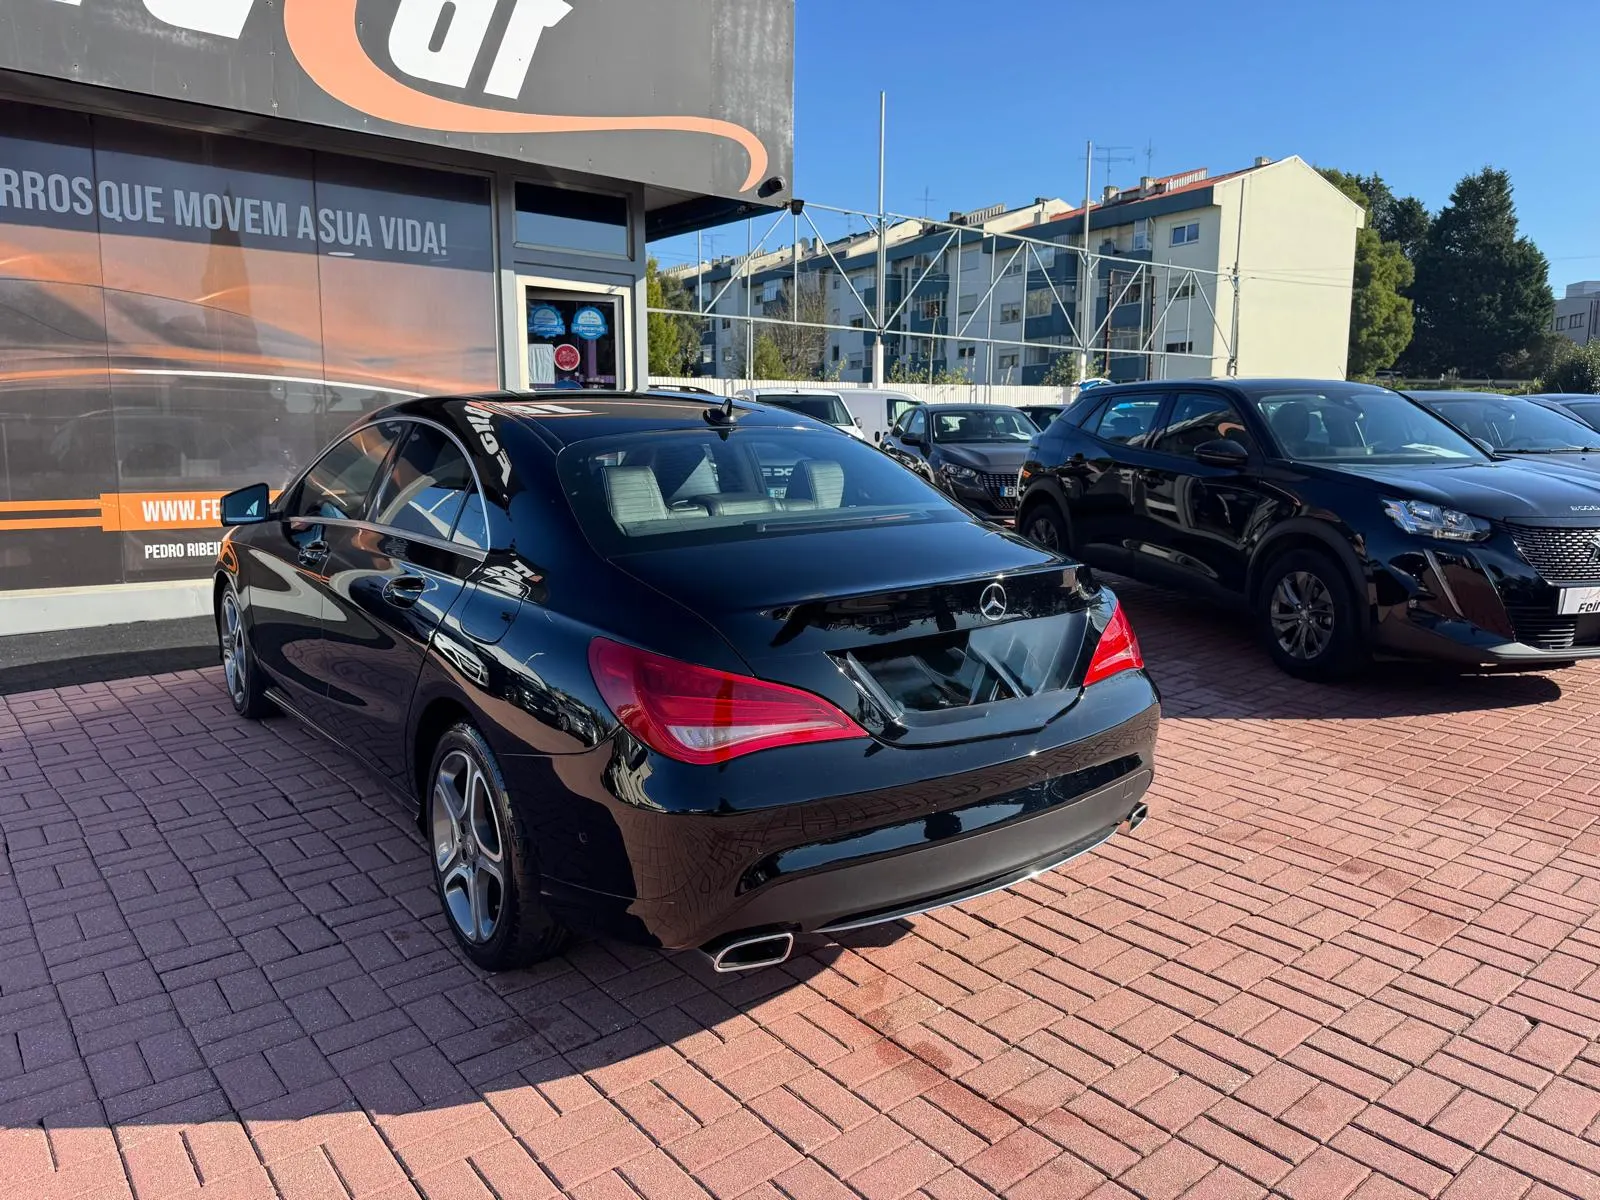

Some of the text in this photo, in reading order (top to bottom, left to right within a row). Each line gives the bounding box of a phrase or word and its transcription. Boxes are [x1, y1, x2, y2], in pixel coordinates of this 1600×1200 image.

[0, 168, 447, 256] RROS QUE MOVEM A SUA VIDA!
[144, 543, 185, 559] PEDRO
